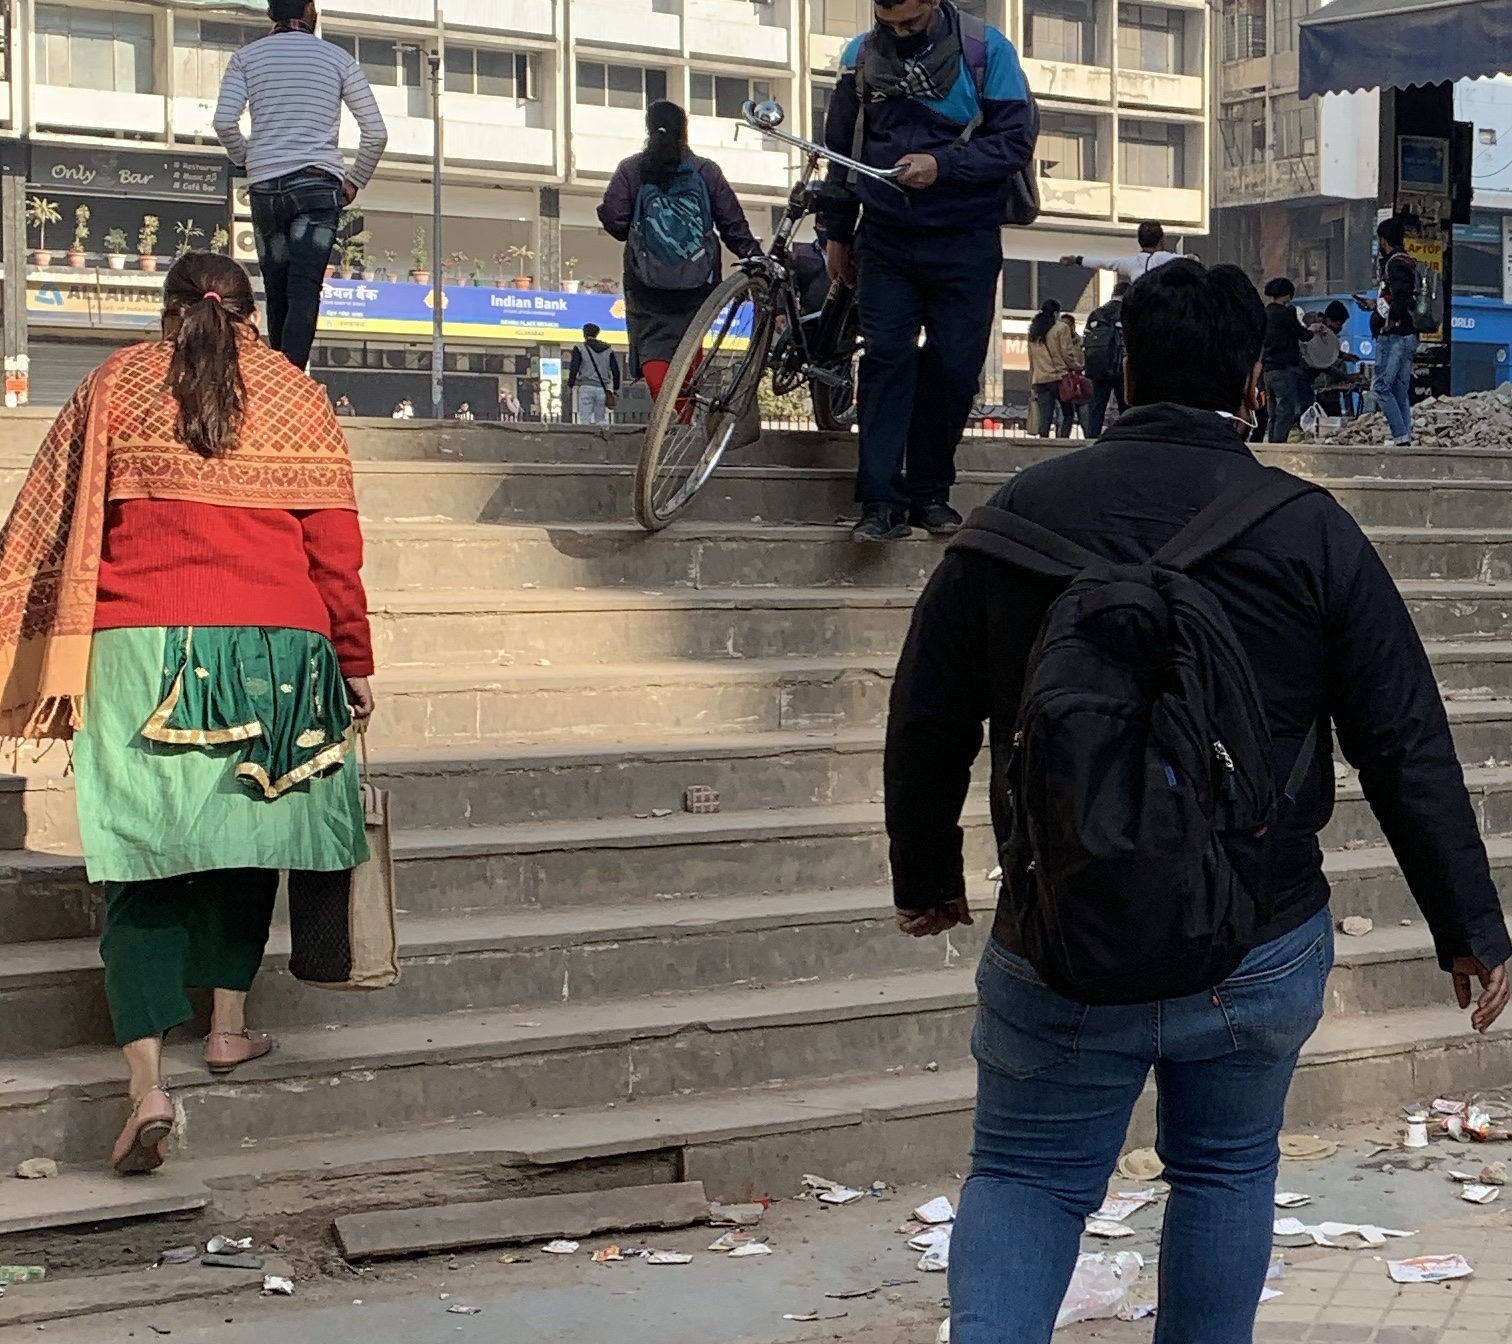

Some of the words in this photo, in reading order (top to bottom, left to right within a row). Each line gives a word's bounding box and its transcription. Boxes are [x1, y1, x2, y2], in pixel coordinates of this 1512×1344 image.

[51, 164, 96, 184] Only
[119, 169, 154, 185] Bar
[491, 293, 531, 310] Indian
[535, 297, 567, 311] Bank
